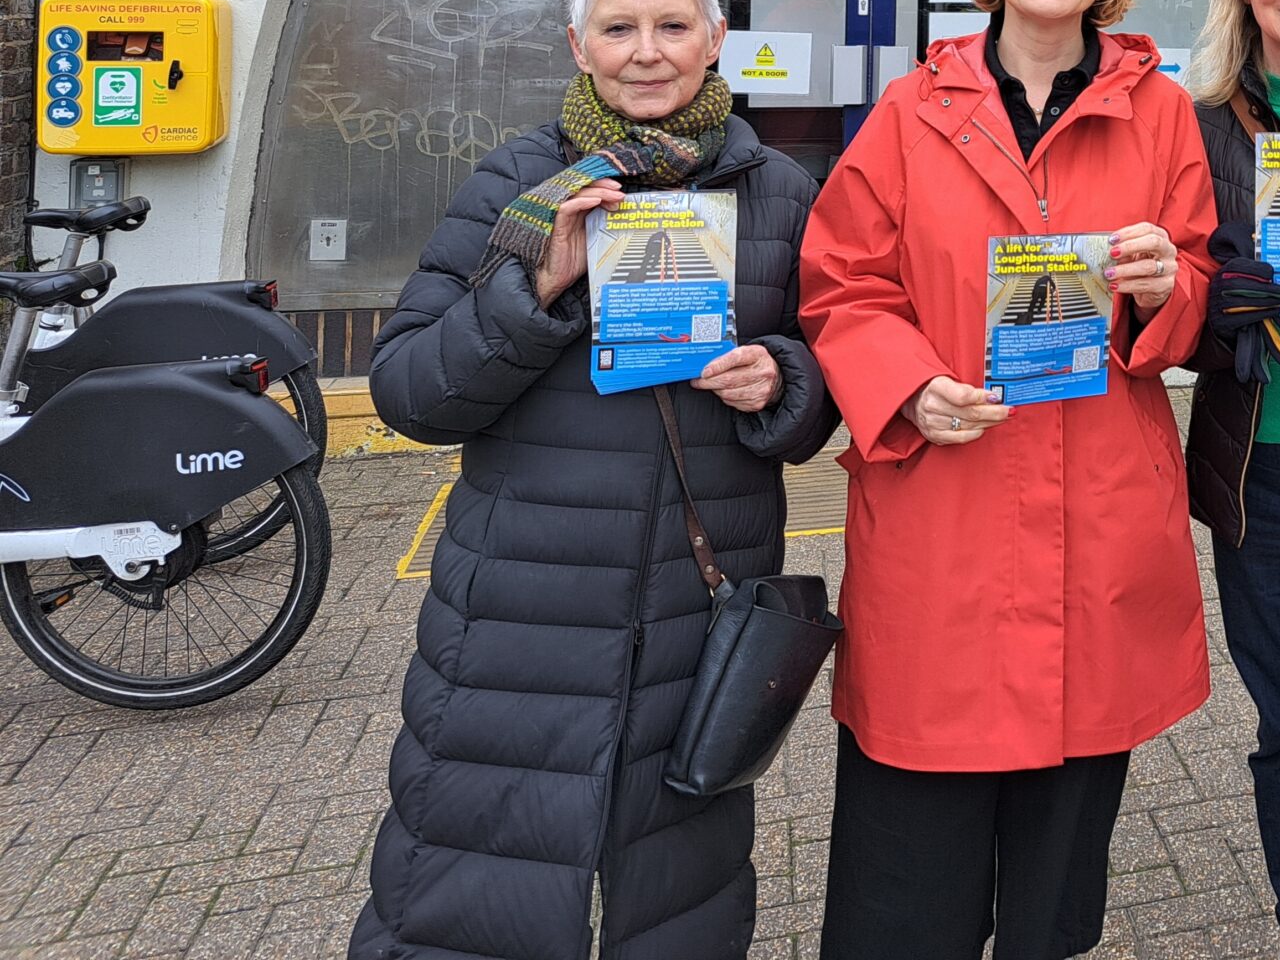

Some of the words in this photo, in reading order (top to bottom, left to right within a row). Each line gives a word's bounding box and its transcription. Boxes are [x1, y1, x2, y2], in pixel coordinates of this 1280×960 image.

[50, 4, 72, 13] LIFE
[75, 5, 116, 13] SAVING
[119, 5, 202, 13] DEFIBRILLATOR
[99, 16, 125, 24] CALL
[127, 16, 145, 24] 999
[160, 127, 198, 135] CARDIAC
[1262, 141, 1270, 149] A
[619, 201, 637, 210] lift
[639, 200, 657, 209] for
[606, 209, 695, 222] Loughborough
[606, 220, 659, 230] Junction
[661, 219, 705, 229] Station
[995, 245, 1004, 253] A
[1006, 243, 1023, 253] lift
[1025, 243, 1042, 253] for
[994, 252, 1078, 265] Loughborough
[994, 263, 1044, 274] Junction
[1046, 262, 1087, 272] Station
[176, 449, 245, 475] Lime
